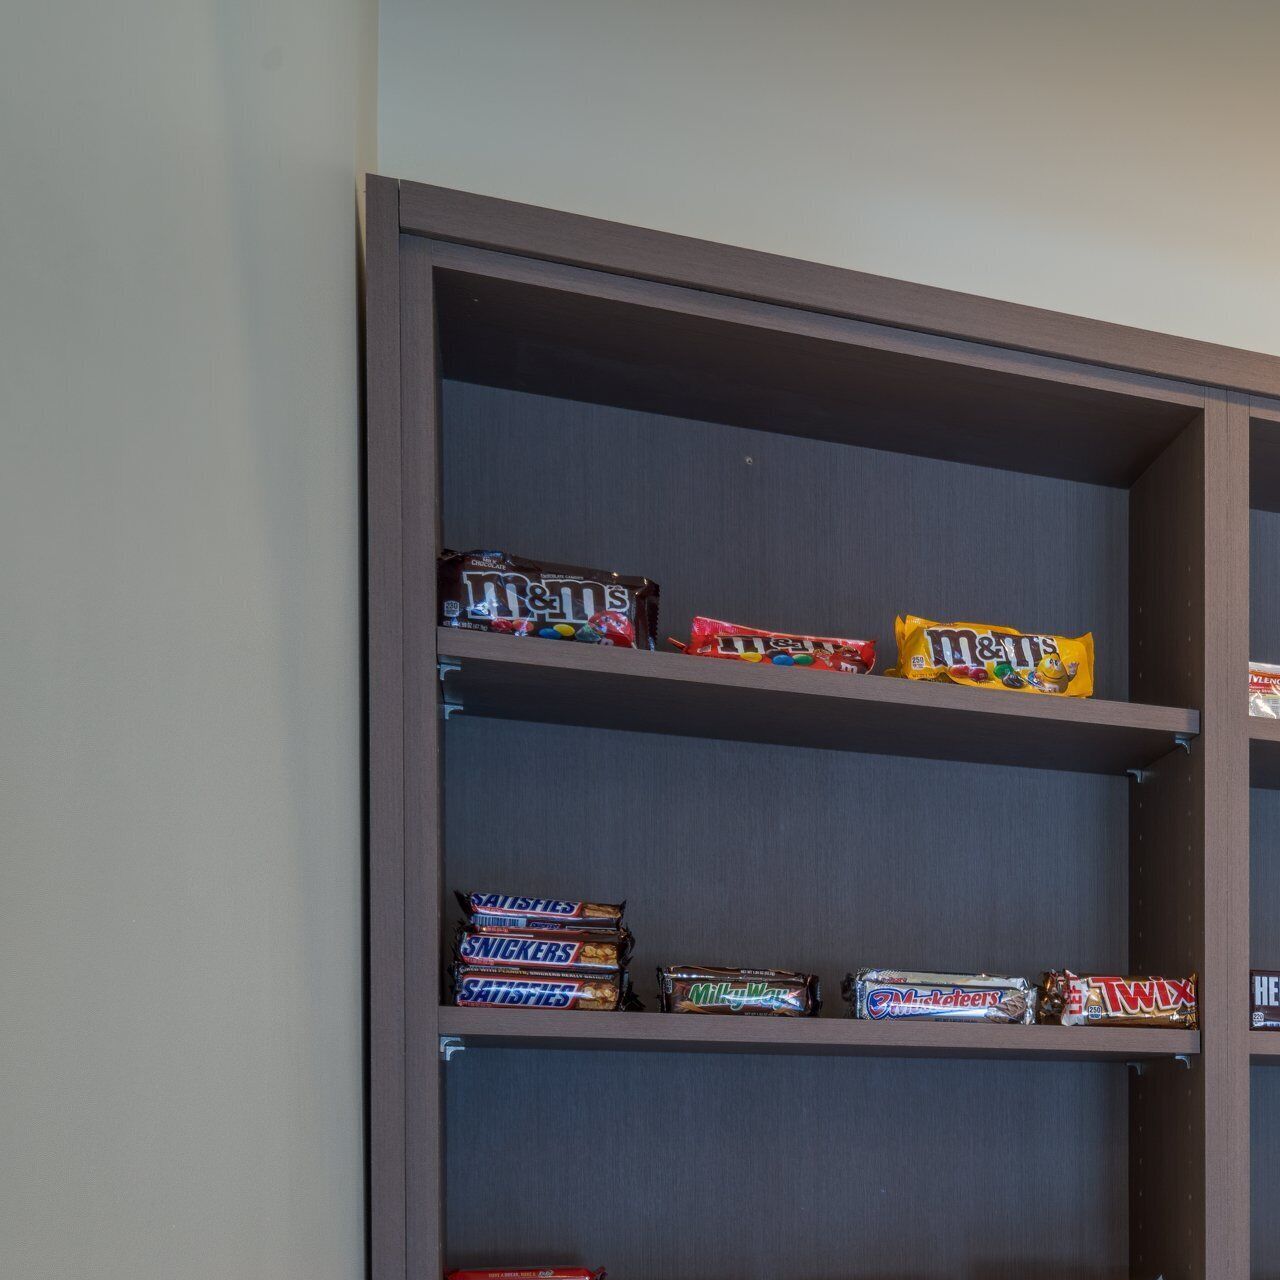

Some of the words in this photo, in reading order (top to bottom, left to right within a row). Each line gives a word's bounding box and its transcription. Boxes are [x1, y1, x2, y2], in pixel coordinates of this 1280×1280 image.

[471, 893, 578, 915] SATISFIES
[461, 936, 577, 965] SNICKERS
[458, 978, 577, 1007] SATISFIES
[869, 991, 893, 1016] 3
[891, 990, 1001, 1016] Musketeers
[1069, 974, 1083, 1015] LEFT
